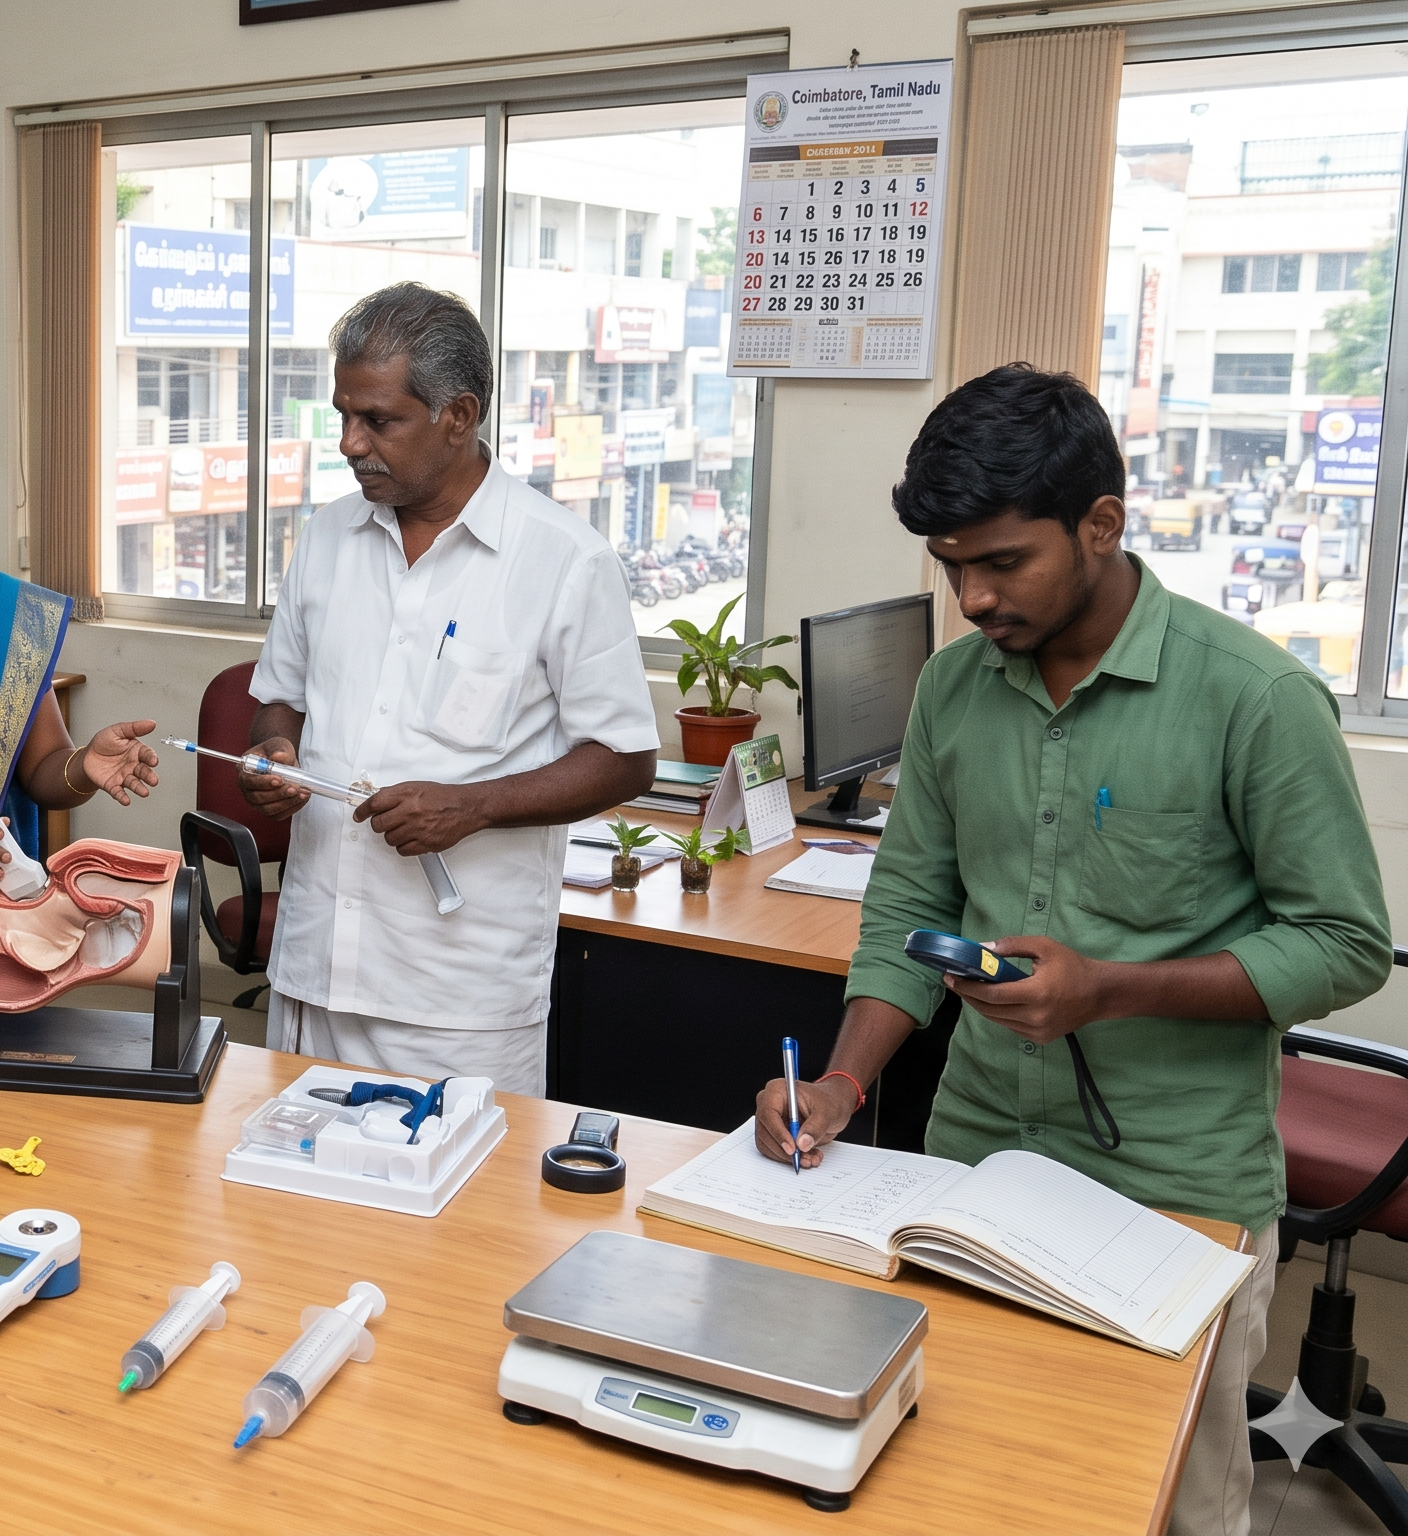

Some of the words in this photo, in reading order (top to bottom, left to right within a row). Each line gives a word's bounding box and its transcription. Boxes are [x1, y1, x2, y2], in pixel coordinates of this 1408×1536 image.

[791, 87, 867, 104] Coimbatore,
[870, 82, 904, 99] Tamil
[907, 80, 941, 97] Nadu
[808, 182, 815, 196] 1
[833, 181, 844, 196] 2
[860, 180, 871, 195] 3
[887, 179, 897, 194] 4
[915, 178, 926, 193] 5
[753, 208, 763, 222] 6
[779, 207, 789, 221] 7
[805, 206, 815, 220] 8
[832, 205, 842, 220] 9
[855, 203, 874, 219] 10
[882, 202, 899, 218] 11
[910, 201, 928, 217] 12
[748, 230, 765, 244] 13
[774, 229, 792, 244] 14
[800, 228, 818, 243] 15
[827, 227, 845, 243] 16
[853, 227, 872, 242] 17
[880, 226, 899, 241] 18
[908, 225, 927, 240] 19
[745, 252, 764, 267] 20
[772, 252, 790, 266] 14
[798, 251, 816, 266] 15
[824, 251, 843, 266] 26
[851, 250, 870, 265] 17
[878, 249, 897, 264] 18
[906, 248, 925, 264] 19
[743, 275, 762, 289] 20
[769, 274, 787, 289] 21
[795, 274, 815, 289] 22
[822, 274, 841, 289] 23
[848, 273, 868, 288] 24
[875, 272, 895, 288] 25
[902, 271, 923, 287] 26
[742, 297, 761, 312] 27
[768, 297, 787, 312] 28
[794, 297, 813, 312] 29
[820, 296, 840, 311] 30
[847, 296, 865, 311] 31
